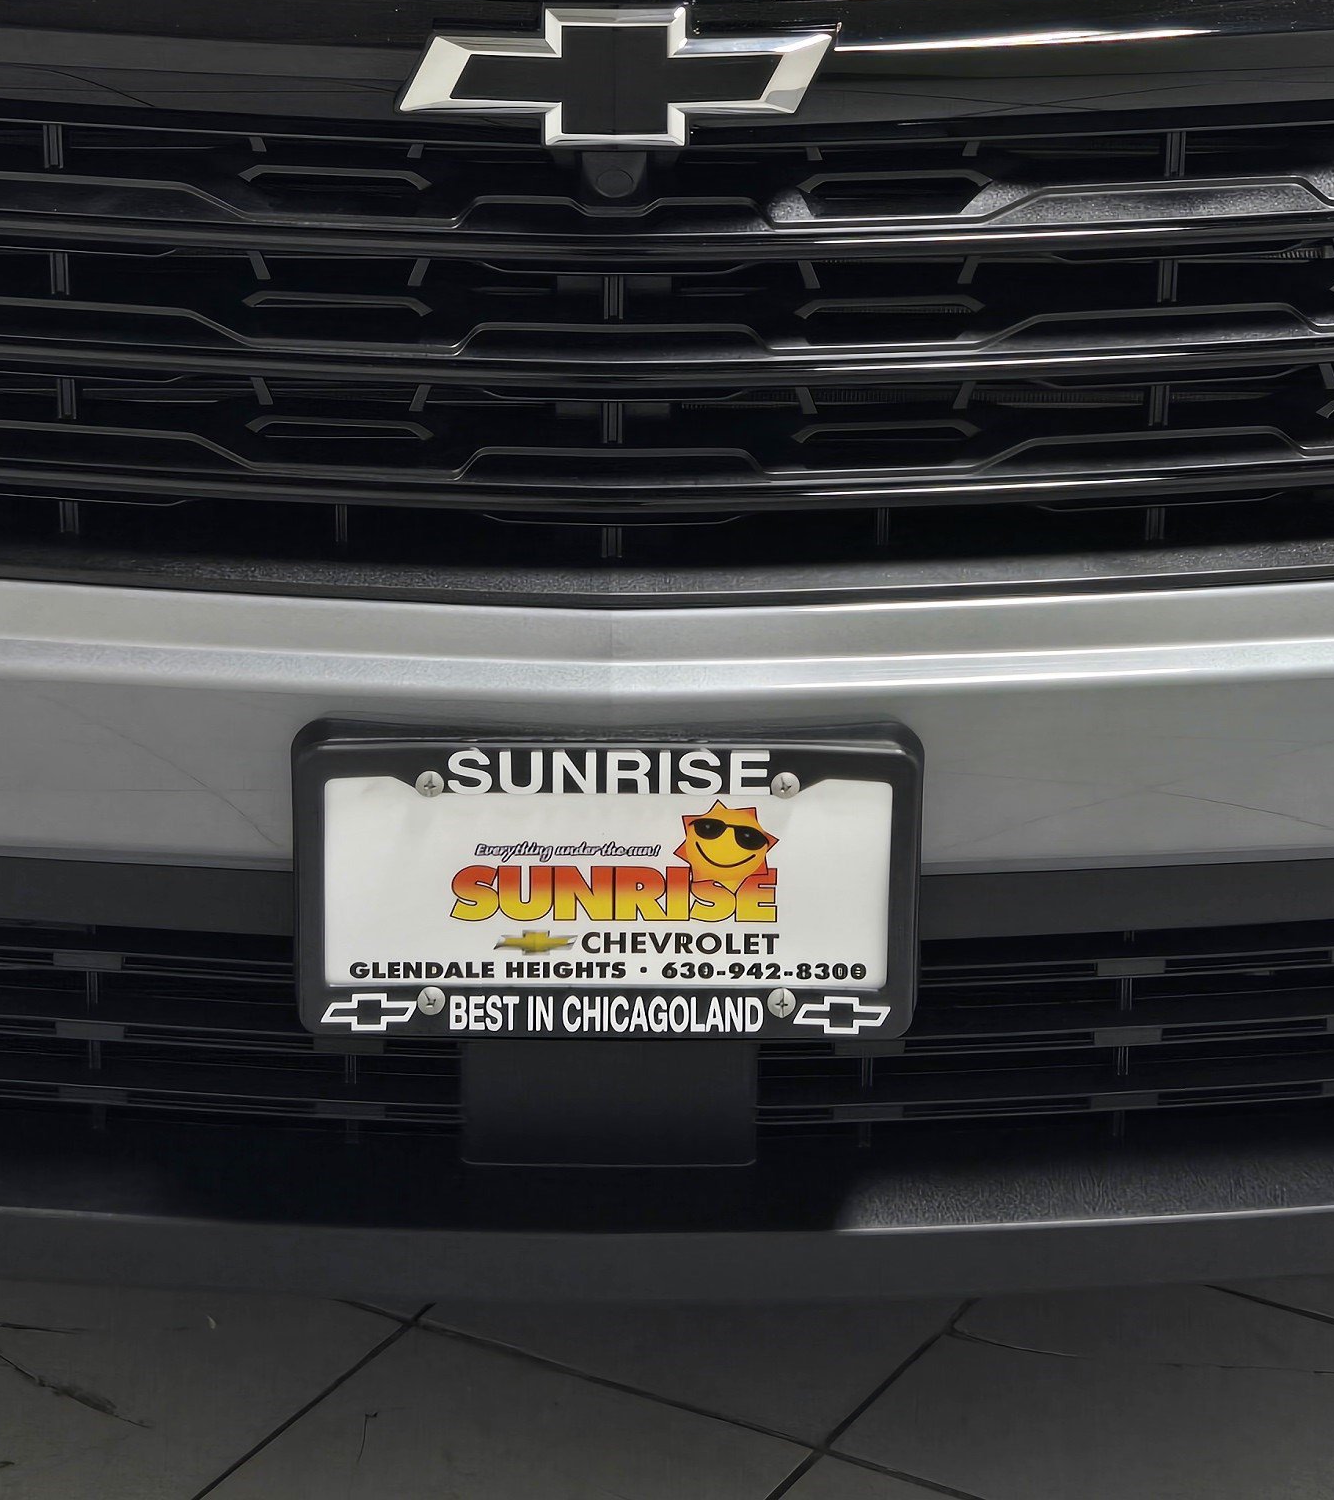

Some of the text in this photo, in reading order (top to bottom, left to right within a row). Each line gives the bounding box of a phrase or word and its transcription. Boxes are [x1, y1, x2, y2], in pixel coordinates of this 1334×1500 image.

[447, 749, 770, 796] SUNRISE
[474, 841, 552, 862] Everything
[555, 842, 599, 857] under
[600, 842, 625, 857] the
[449, 864, 778, 923] SUNRISE
[581, 931, 780, 955] CHEVROLET
[349, 961, 867, 980] GLENDALE HEIGHTS 630-942-8300
[449, 995, 764, 1033] BEST IN CHICAGOLAND
